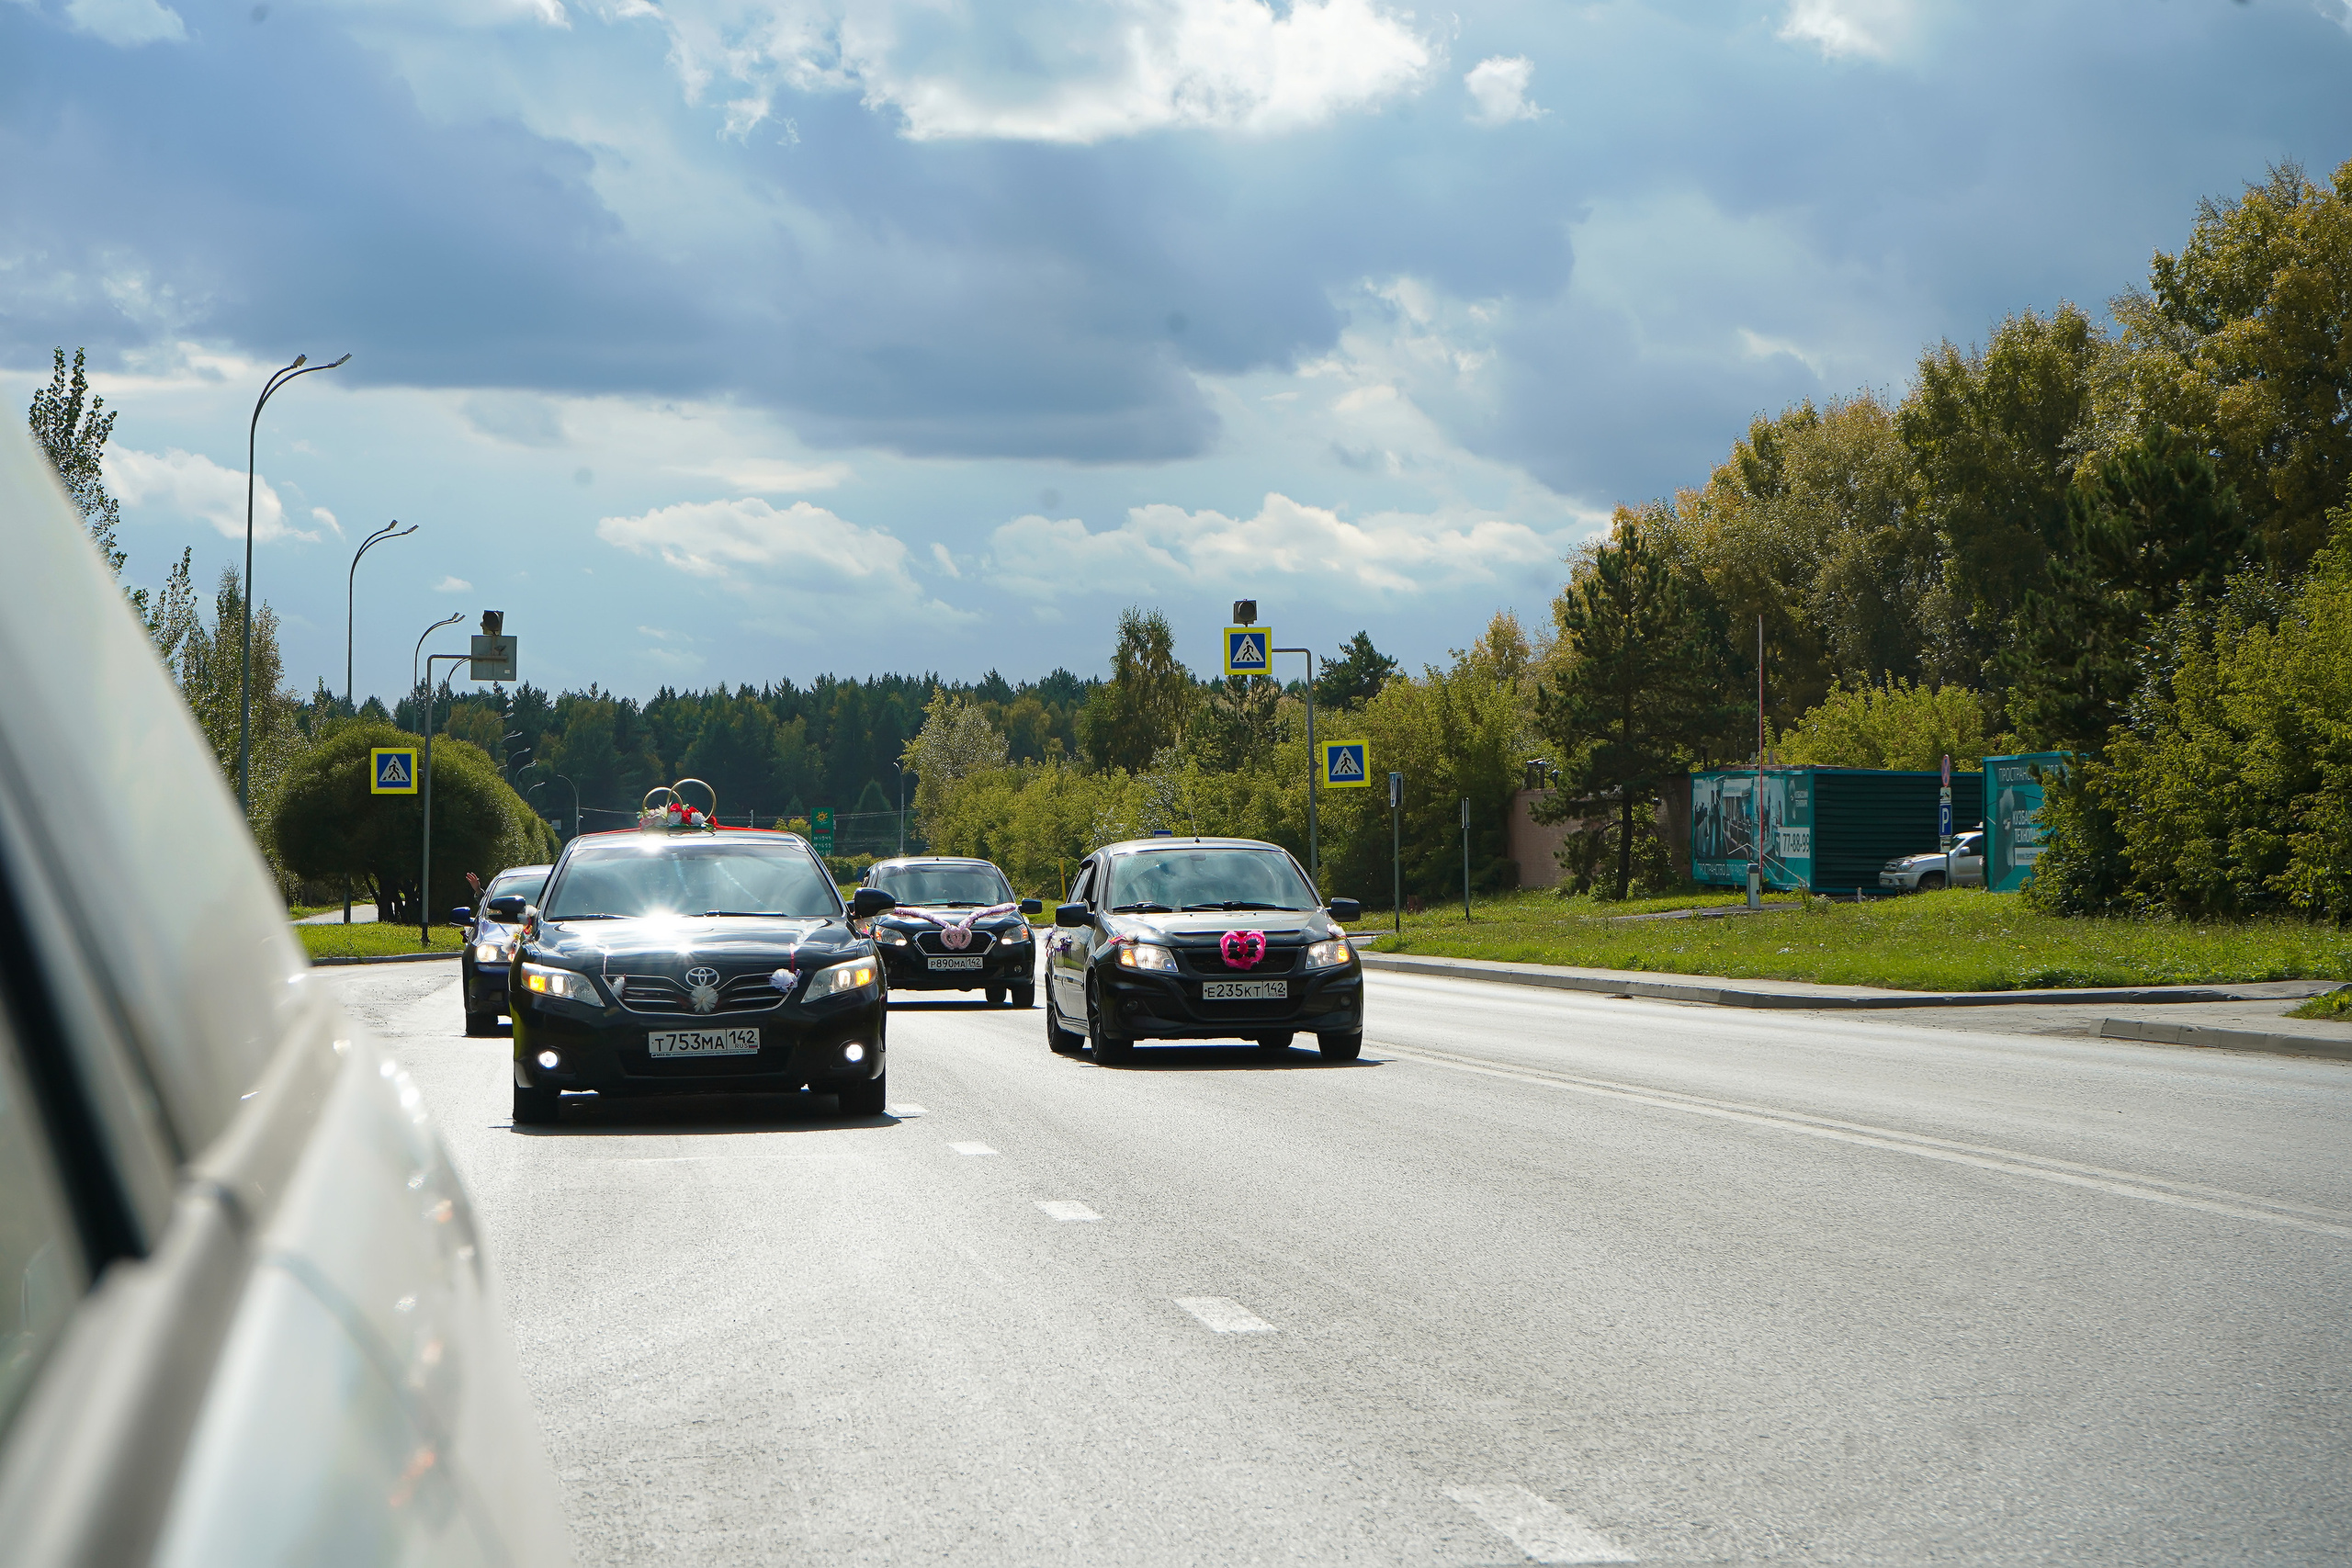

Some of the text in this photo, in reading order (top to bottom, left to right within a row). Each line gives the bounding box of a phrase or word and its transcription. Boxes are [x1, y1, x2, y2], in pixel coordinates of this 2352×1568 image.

[1941, 808, 1950, 833] P
[1782, 832, 1810, 853] 77-88-99
[1263, 982, 1284, 993] 142
[729, 1030, 755, 1044] 142
